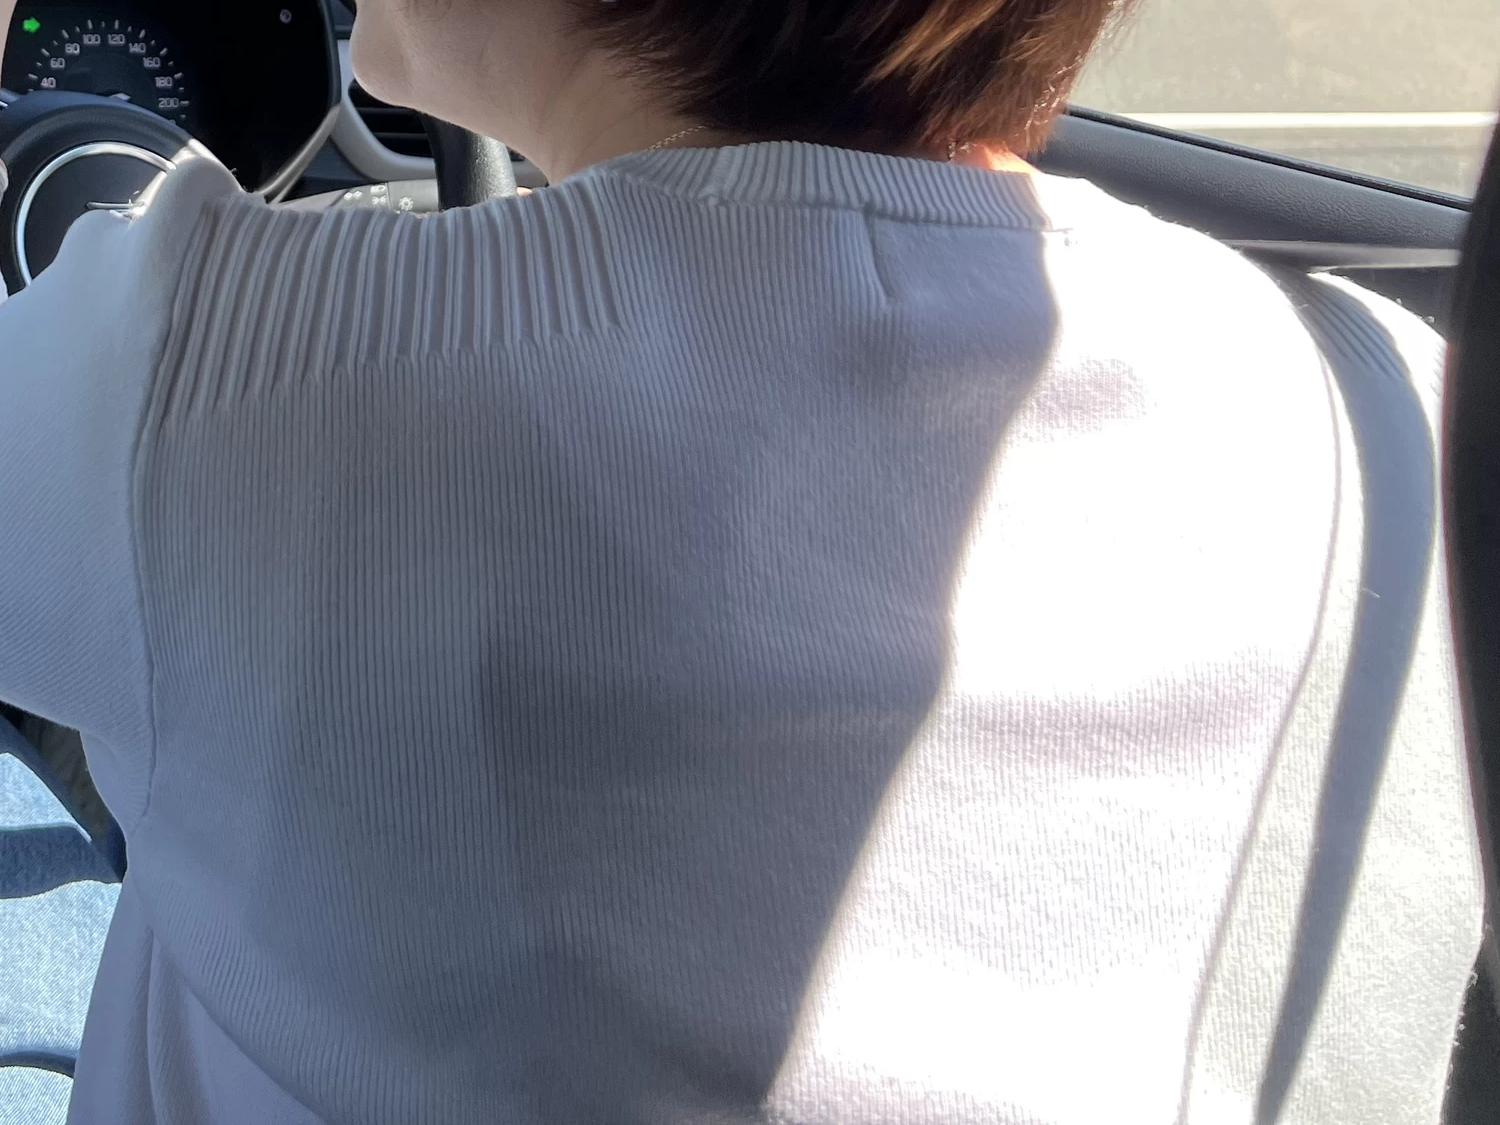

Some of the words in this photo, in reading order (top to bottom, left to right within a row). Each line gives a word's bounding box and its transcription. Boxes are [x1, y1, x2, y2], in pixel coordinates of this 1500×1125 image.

[82, 33, 101, 45] 100
[107, 33, 125, 45] 120
[64, 42, 81, 55] 80
[128, 42, 146, 54] 140
[50, 57, 66, 69] 60
[142, 57, 161, 69] 160
[40, 77, 56, 89] 40
[155, 76, 173, 88] 180
[158, 97, 179, 108] 200
